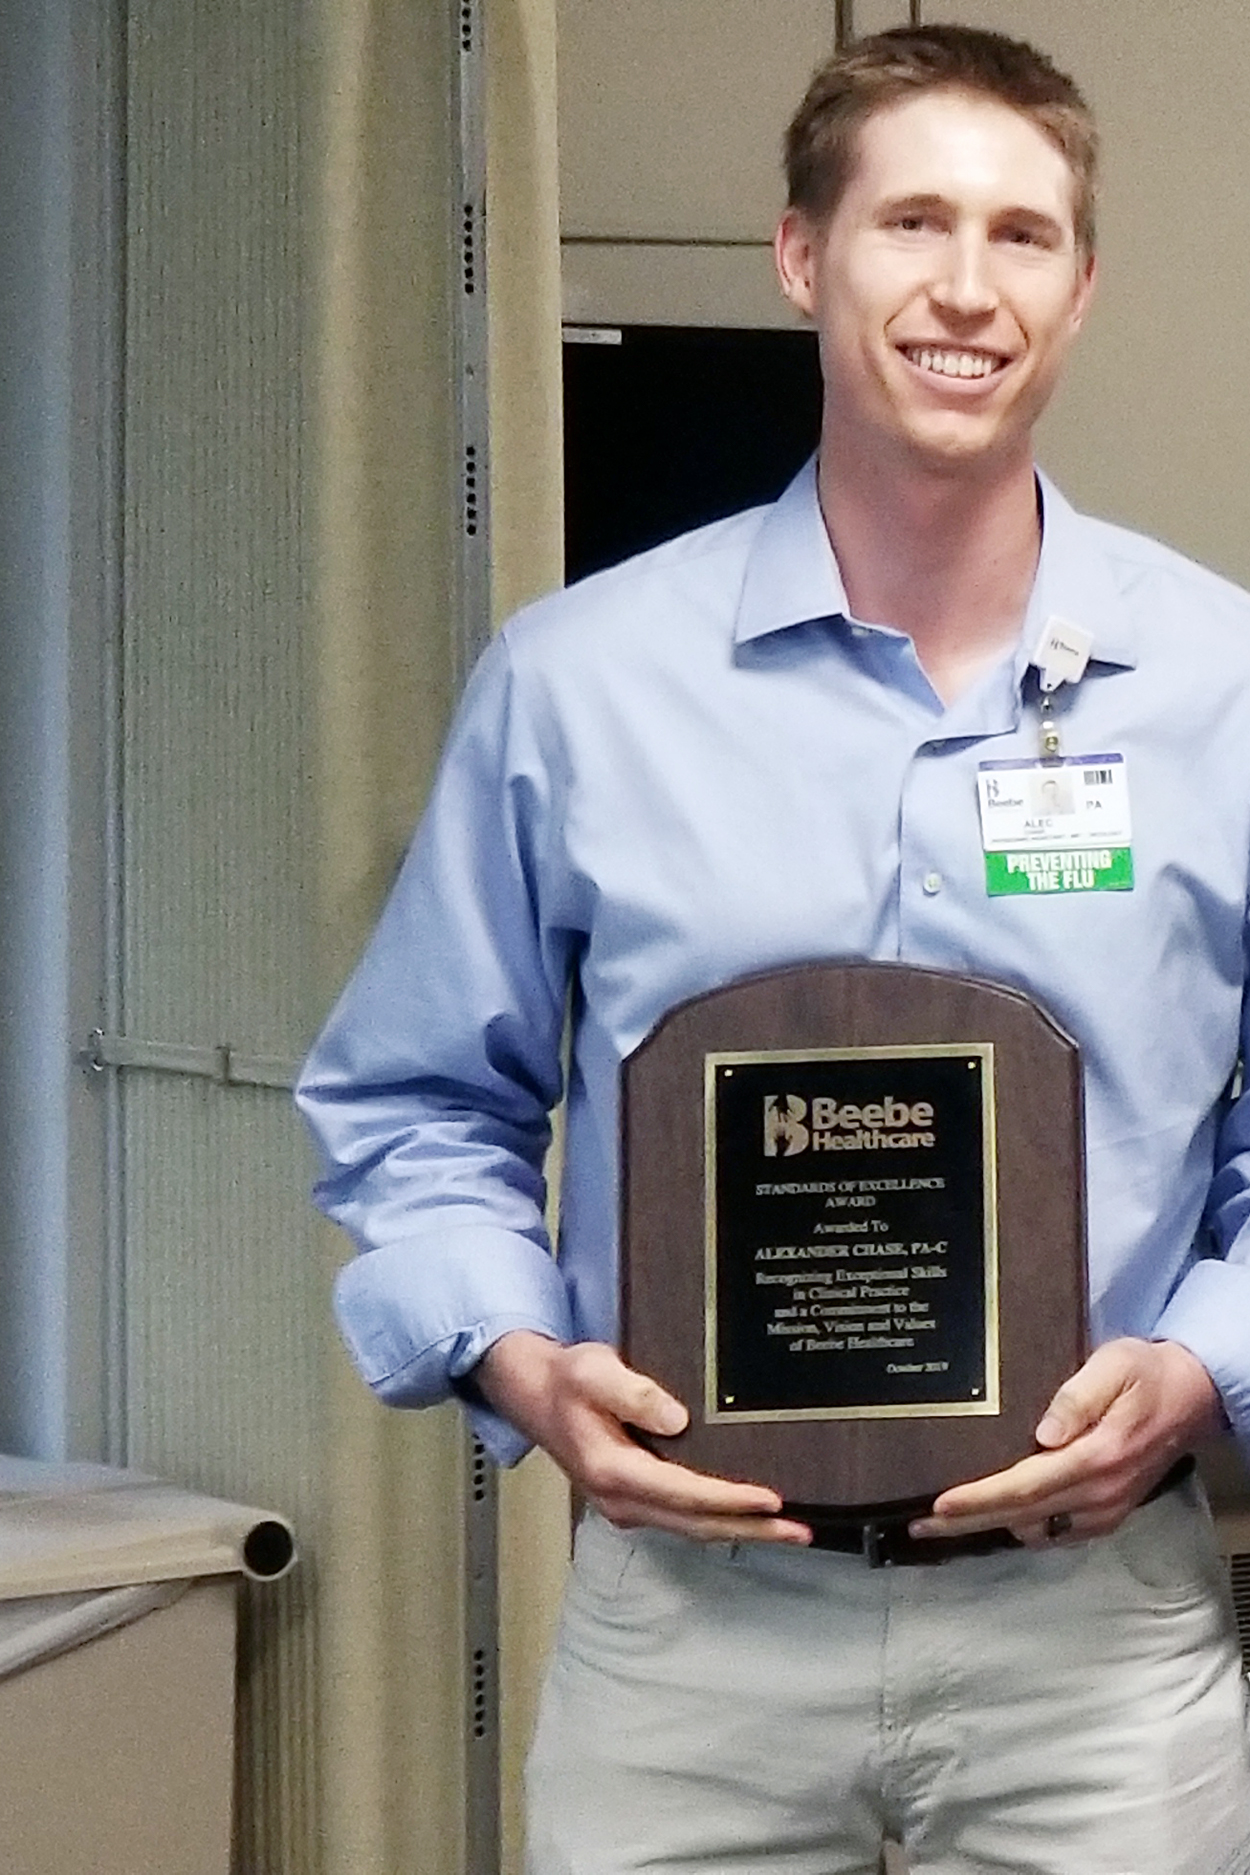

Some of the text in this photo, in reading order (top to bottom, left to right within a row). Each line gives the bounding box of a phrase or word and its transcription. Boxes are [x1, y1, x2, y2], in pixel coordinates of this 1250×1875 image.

[1024, 819, 1053, 828] ALEC
[1007, 850, 1113, 873] PREVENTING
[1027, 869, 1095, 891] THE FLU
[812, 1096, 934, 1130] Beebe
[812, 1130, 936, 1151] Healthcare
[755, 1177, 946, 1196] STANDARDS OF EXCELLENCE
[825, 1196, 876, 1208] AWARD
[813, 1220, 889, 1234] Awarded To
[754, 1241, 949, 1261] ALEXANDER CHASE, PA-C
[755, 1265, 948, 1287] Recognizing Exceptional Skills
[809, 1286, 858, 1299] Clinical
[860, 1284, 910, 1298] Practice
[774, 1306, 798, 1318] and
[810, 1303, 891, 1317] Commitment
[893, 1302, 907, 1313] to
[909, 1301, 930, 1313] the
[767, 1317, 936, 1335] Mission, Vision and Values
[848, 1336, 915, 1350] Healthcare
